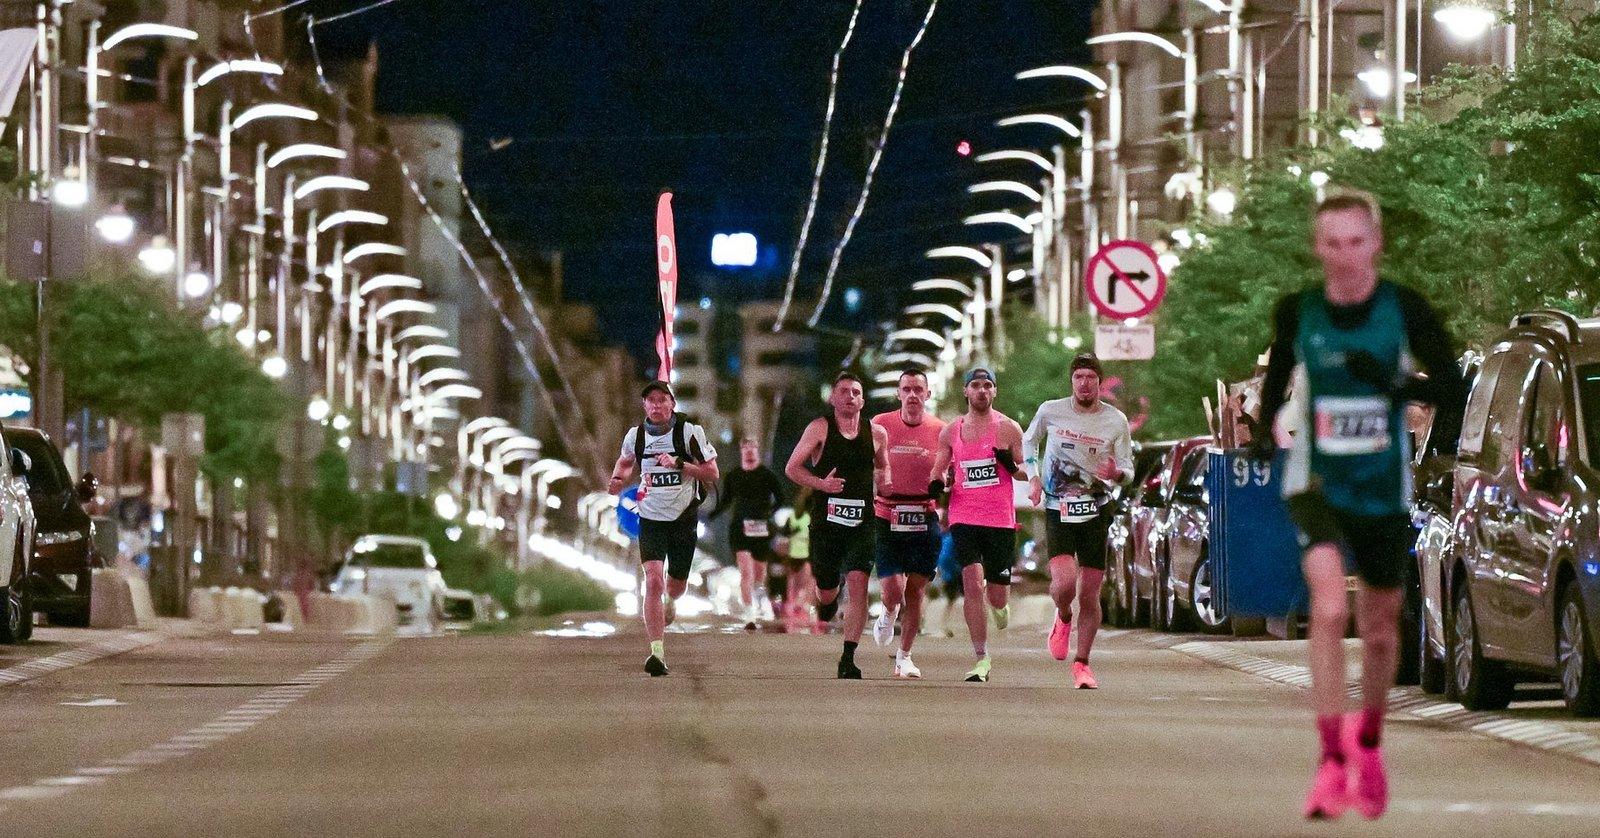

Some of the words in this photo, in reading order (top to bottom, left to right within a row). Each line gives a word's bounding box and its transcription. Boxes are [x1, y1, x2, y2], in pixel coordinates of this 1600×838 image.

[968, 467, 996, 479] 4062
[1233, 456, 1271, 487] 99
[652, 474, 680, 485] 4112
[835, 506, 863, 518] 2431
[1068, 502, 1097, 514] 4554
[899, 513, 926, 523] 1143
